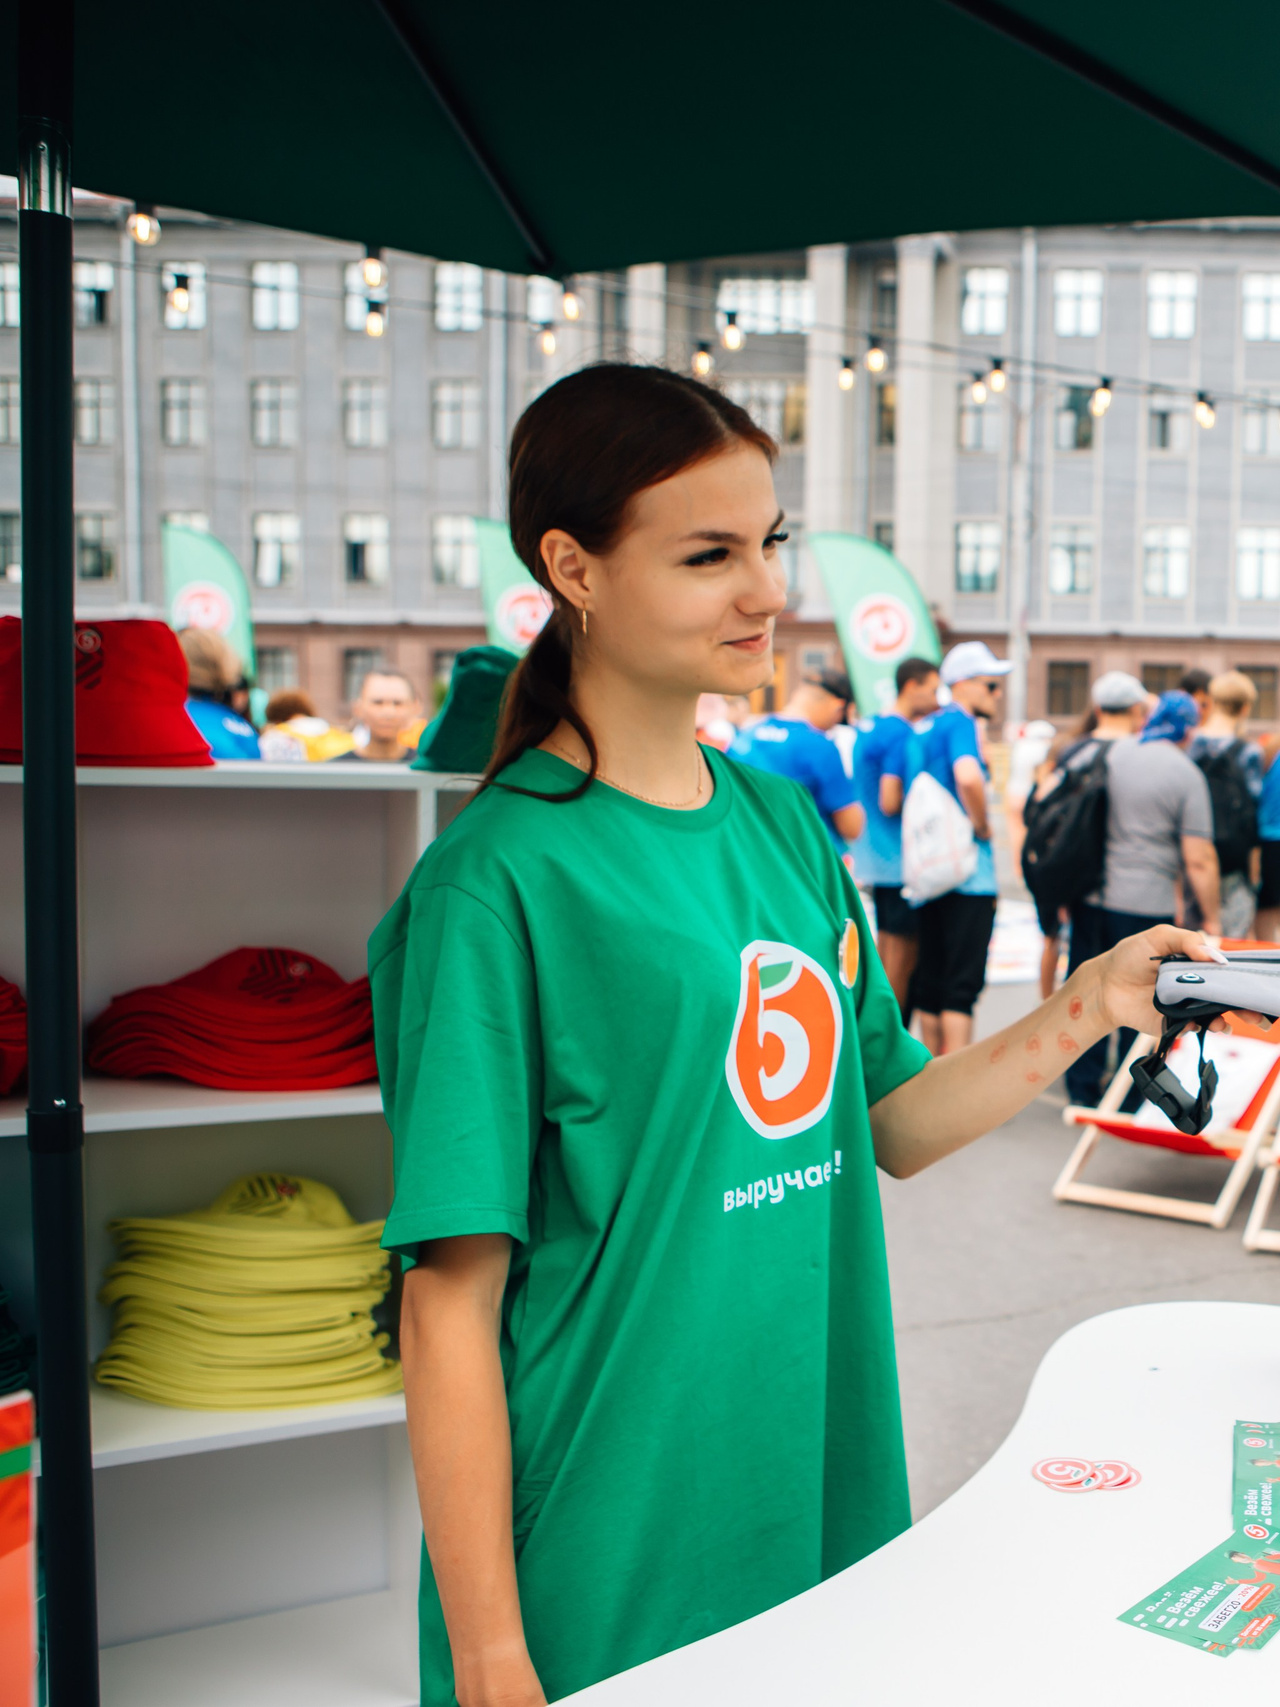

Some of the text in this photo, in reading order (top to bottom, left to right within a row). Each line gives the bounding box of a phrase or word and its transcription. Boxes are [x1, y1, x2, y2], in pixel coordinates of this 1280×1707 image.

[1244, 1489, 1258, 1516] Везём
[1166, 1584, 1205, 1615] Везём
[1184, 1581, 1227, 1618] свежее!
[1207, 1600, 1241, 1630] ЗАБЕГ20
